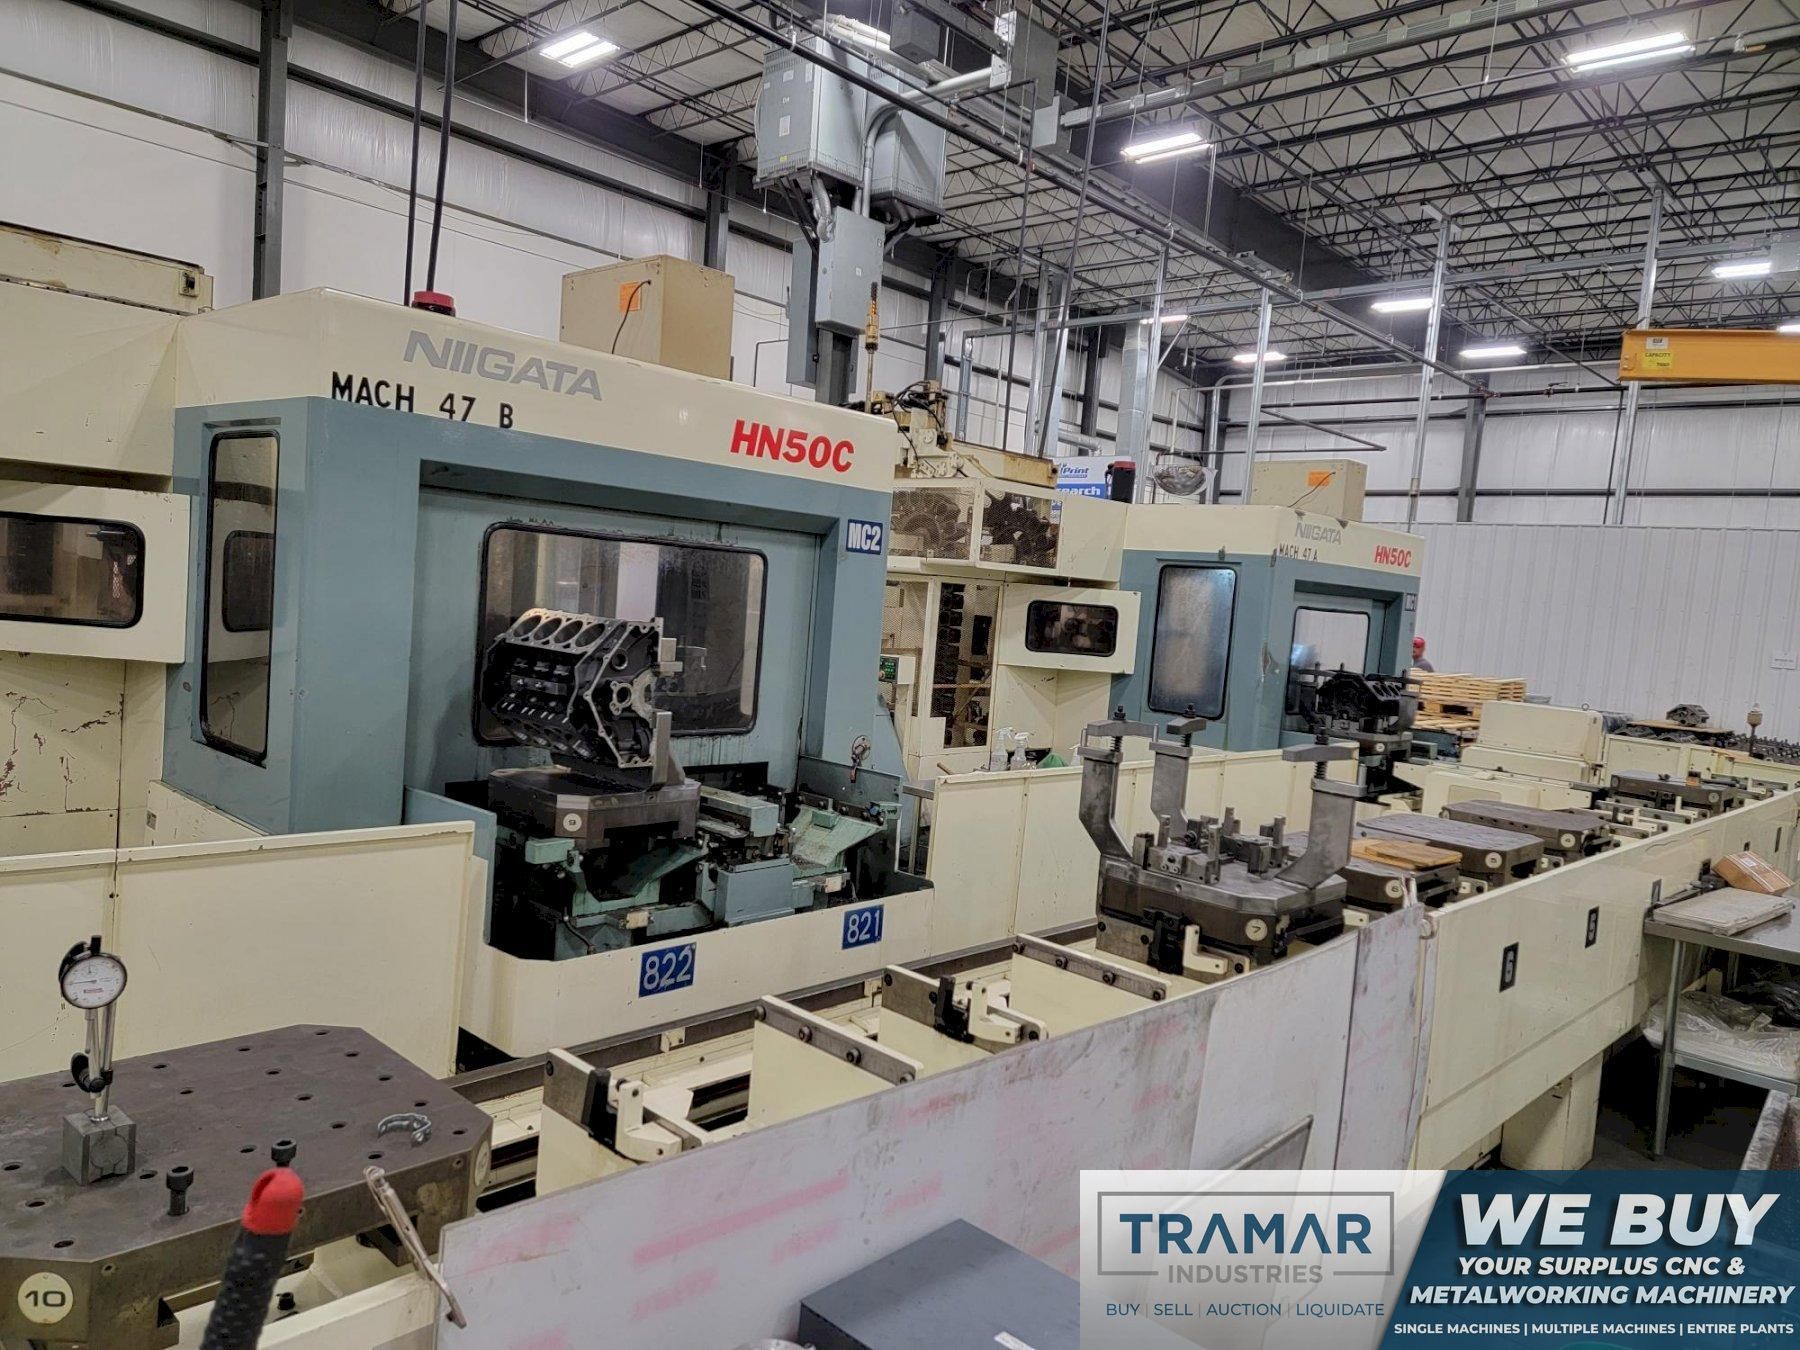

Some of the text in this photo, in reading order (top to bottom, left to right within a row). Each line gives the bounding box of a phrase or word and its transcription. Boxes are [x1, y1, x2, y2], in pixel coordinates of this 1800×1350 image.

[403, 330, 602, 400] NIIGATA
[332, 372, 514, 429] MACH 47 B
[730, 419, 855, 473] HN50C
[848, 523, 882, 551] MC2
[1295, 522, 1342, 545] NIIGATA
[1279, 543, 1299, 559] MACH
[1374, 545, 1412, 568] HN50C
[847, 909, 881, 943] 821
[1251, 925, 1262, 934] 7
[643, 945, 693, 990] 822
[24, 1290, 66, 1307] 10
